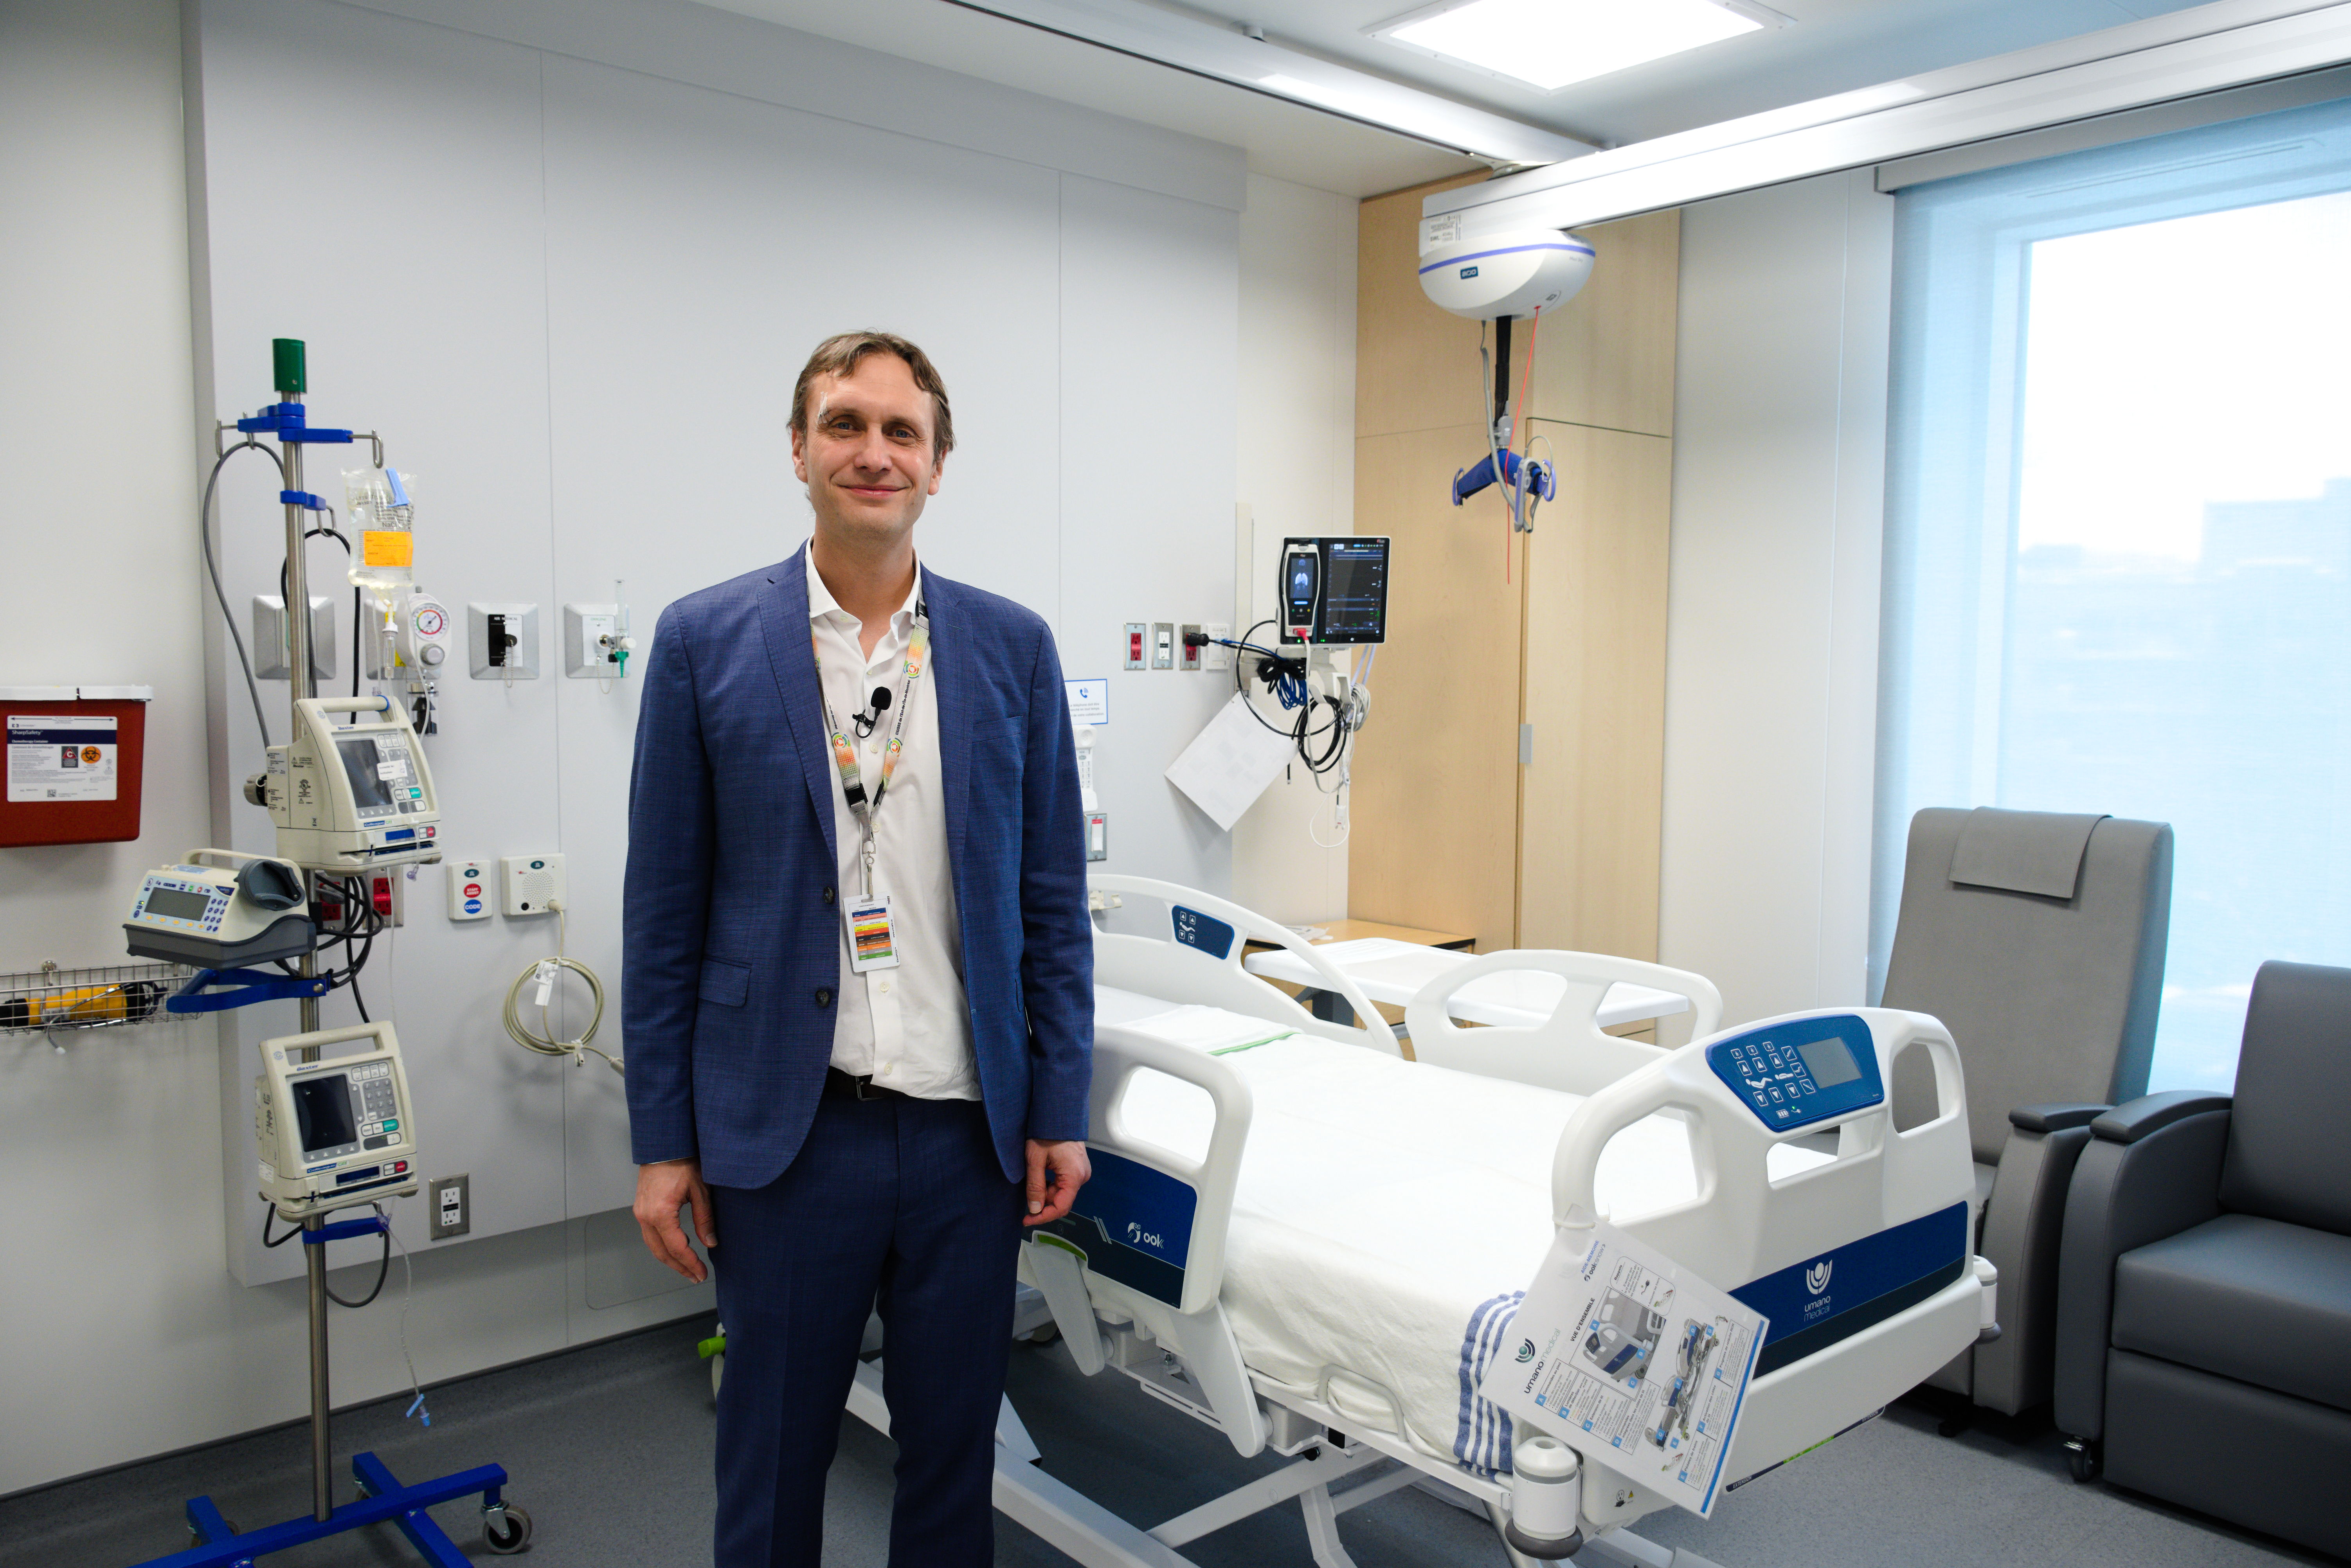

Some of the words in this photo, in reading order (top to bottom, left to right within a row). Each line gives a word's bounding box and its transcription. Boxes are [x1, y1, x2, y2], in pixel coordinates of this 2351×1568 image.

[1580, 1239, 1599, 1273] AIDE-MÉMOIRE
[1614, 1264, 1623, 1280] Rappels
[1804, 1295, 1831, 1312] umano
[1570, 1330, 1579, 1342] VUE
[1575, 1297, 1595, 1331] D'ENSEMBLE
[1804, 1303, 1830, 1322] medical
[1542, 1374, 1555, 1395] Commandes
[1564, 1391, 1574, 1407] Lumières
[1570, 1388, 1580, 1404] détection
[1589, 1403, 1599, 1420] Extension
[1702, 1402, 1710, 1421] Activation
[1618, 1415, 1629, 1436] Commandes
[1683, 1456, 1692, 1472] Pédales
[1732, 1475, 1752, 1489] EXTENSION
